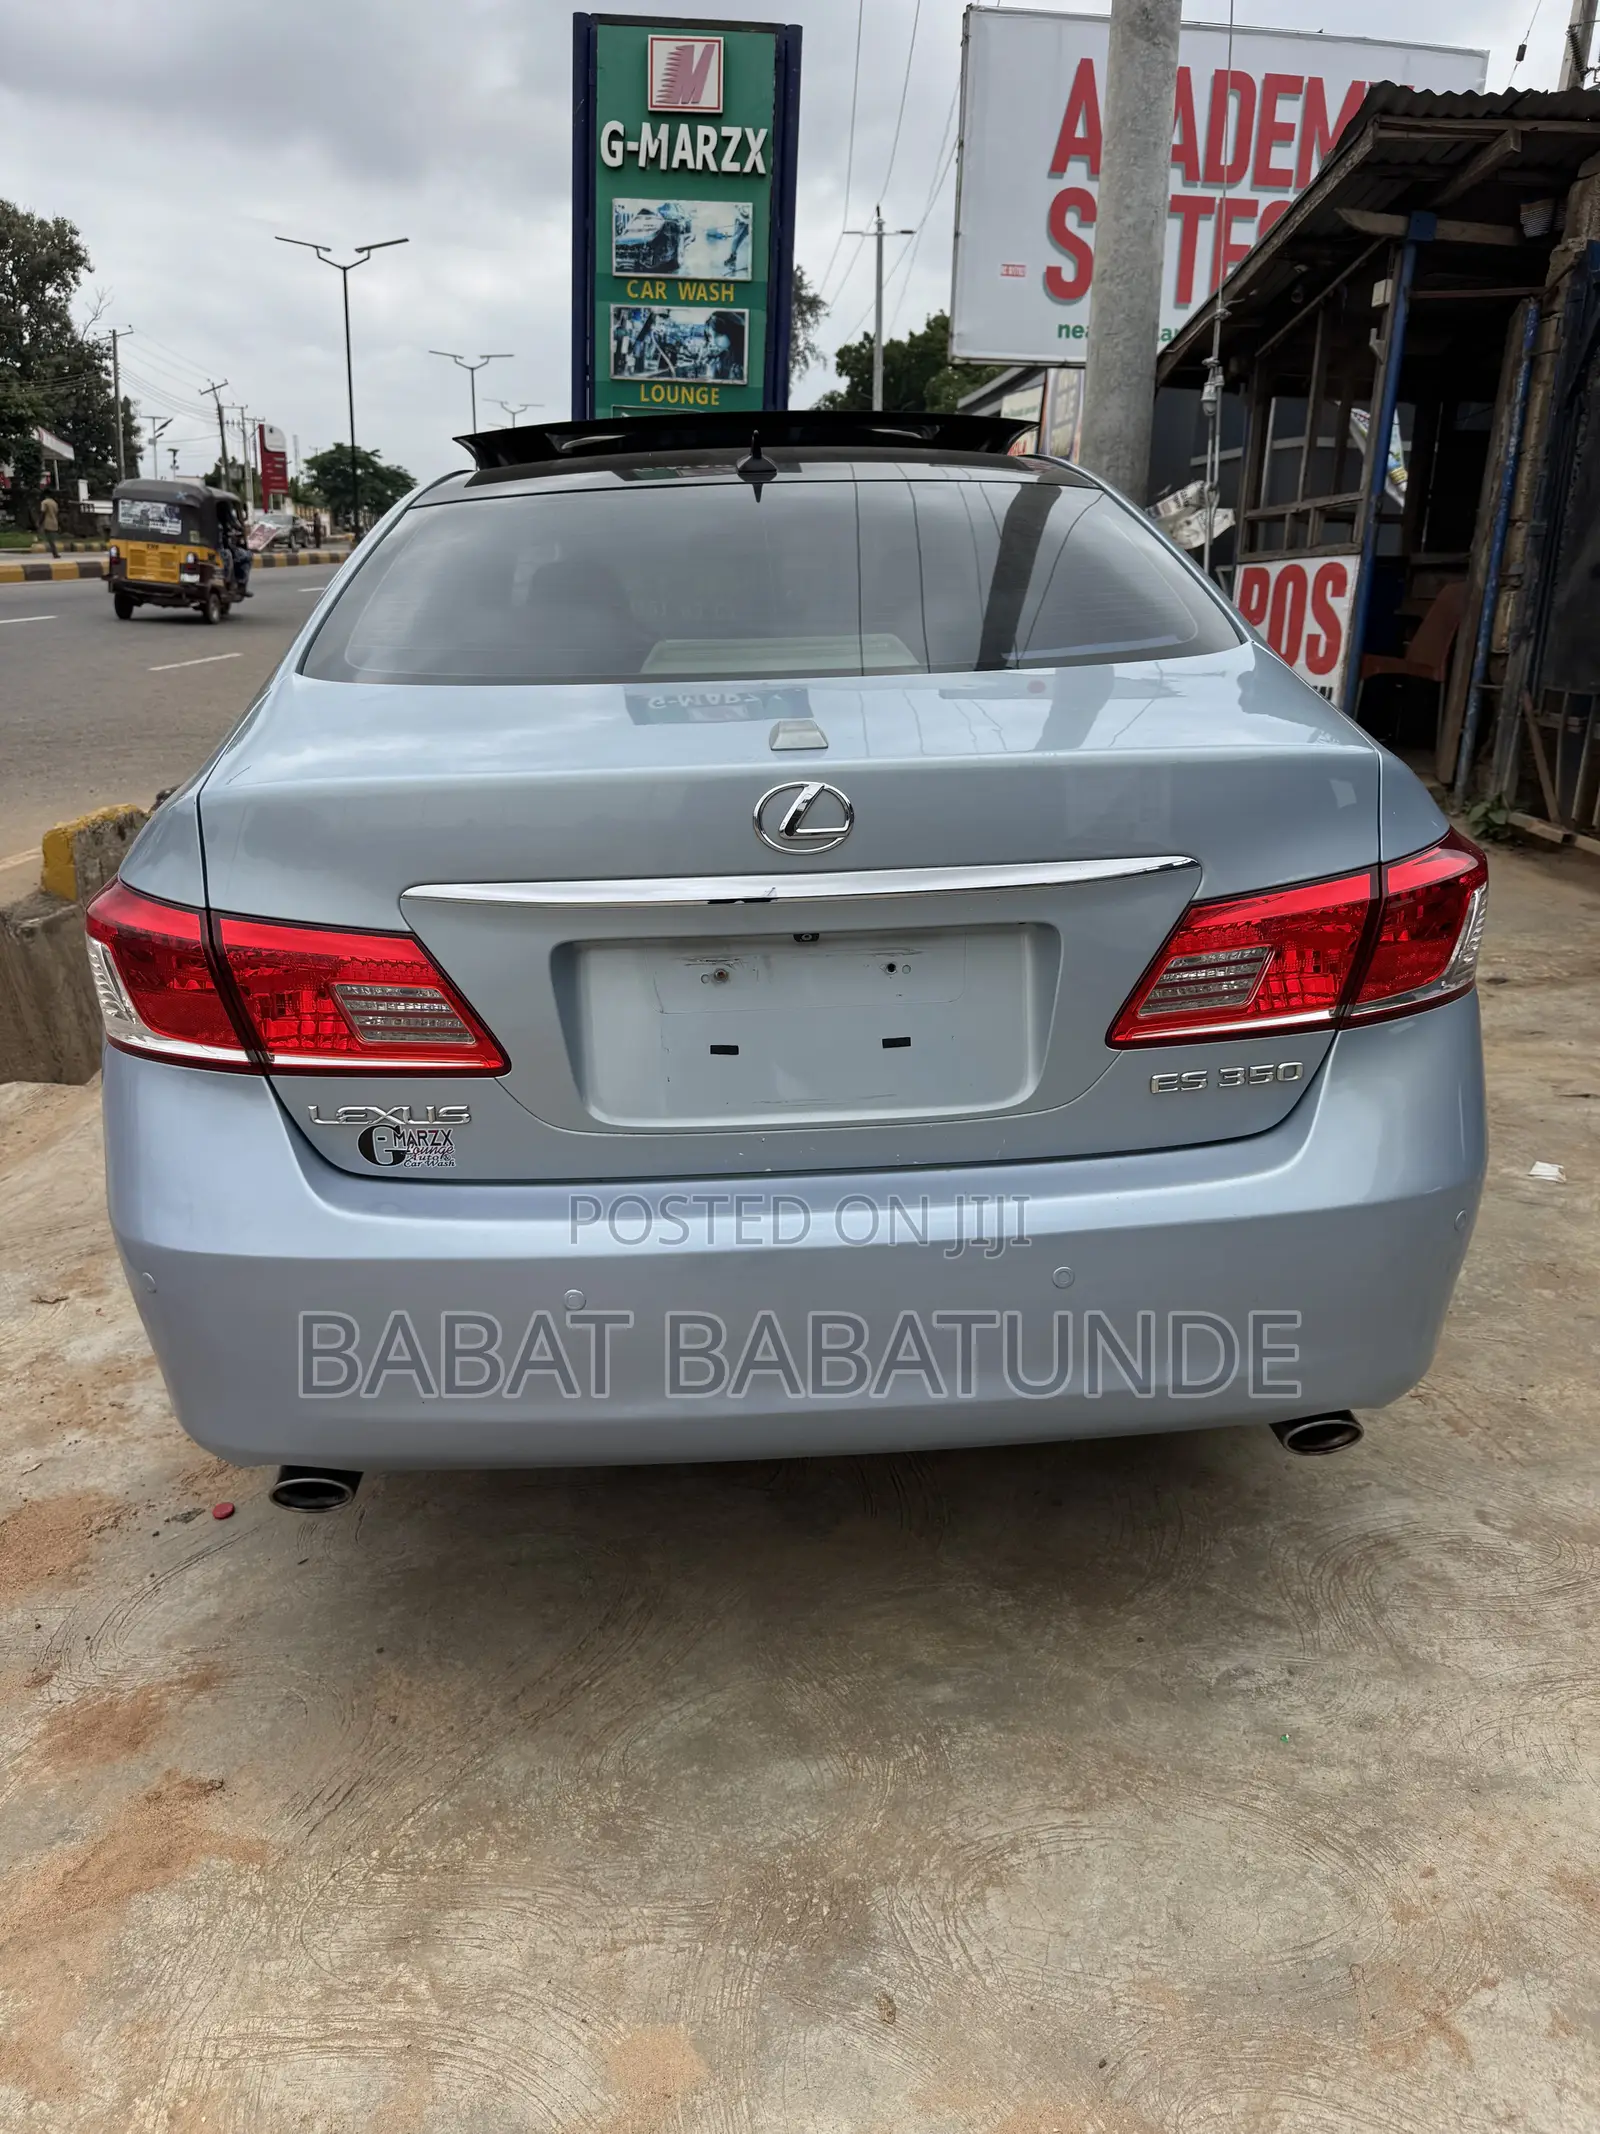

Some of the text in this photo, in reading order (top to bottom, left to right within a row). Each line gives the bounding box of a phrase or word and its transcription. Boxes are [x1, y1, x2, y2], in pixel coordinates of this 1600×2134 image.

[1050, 57, 1414, 190] AADEM
[600, 120, 768, 175] G-MARZX
[626, 279, 735, 302] CAR WASH
[640, 383, 720, 406] LOUNGE
[1238, 561, 1348, 676] POS
[1151, 1061, 1304, 1094] ES 350
[307, 1105, 472, 1125] LEXUS
[403, 1159, 456, 1168] Car Wash
